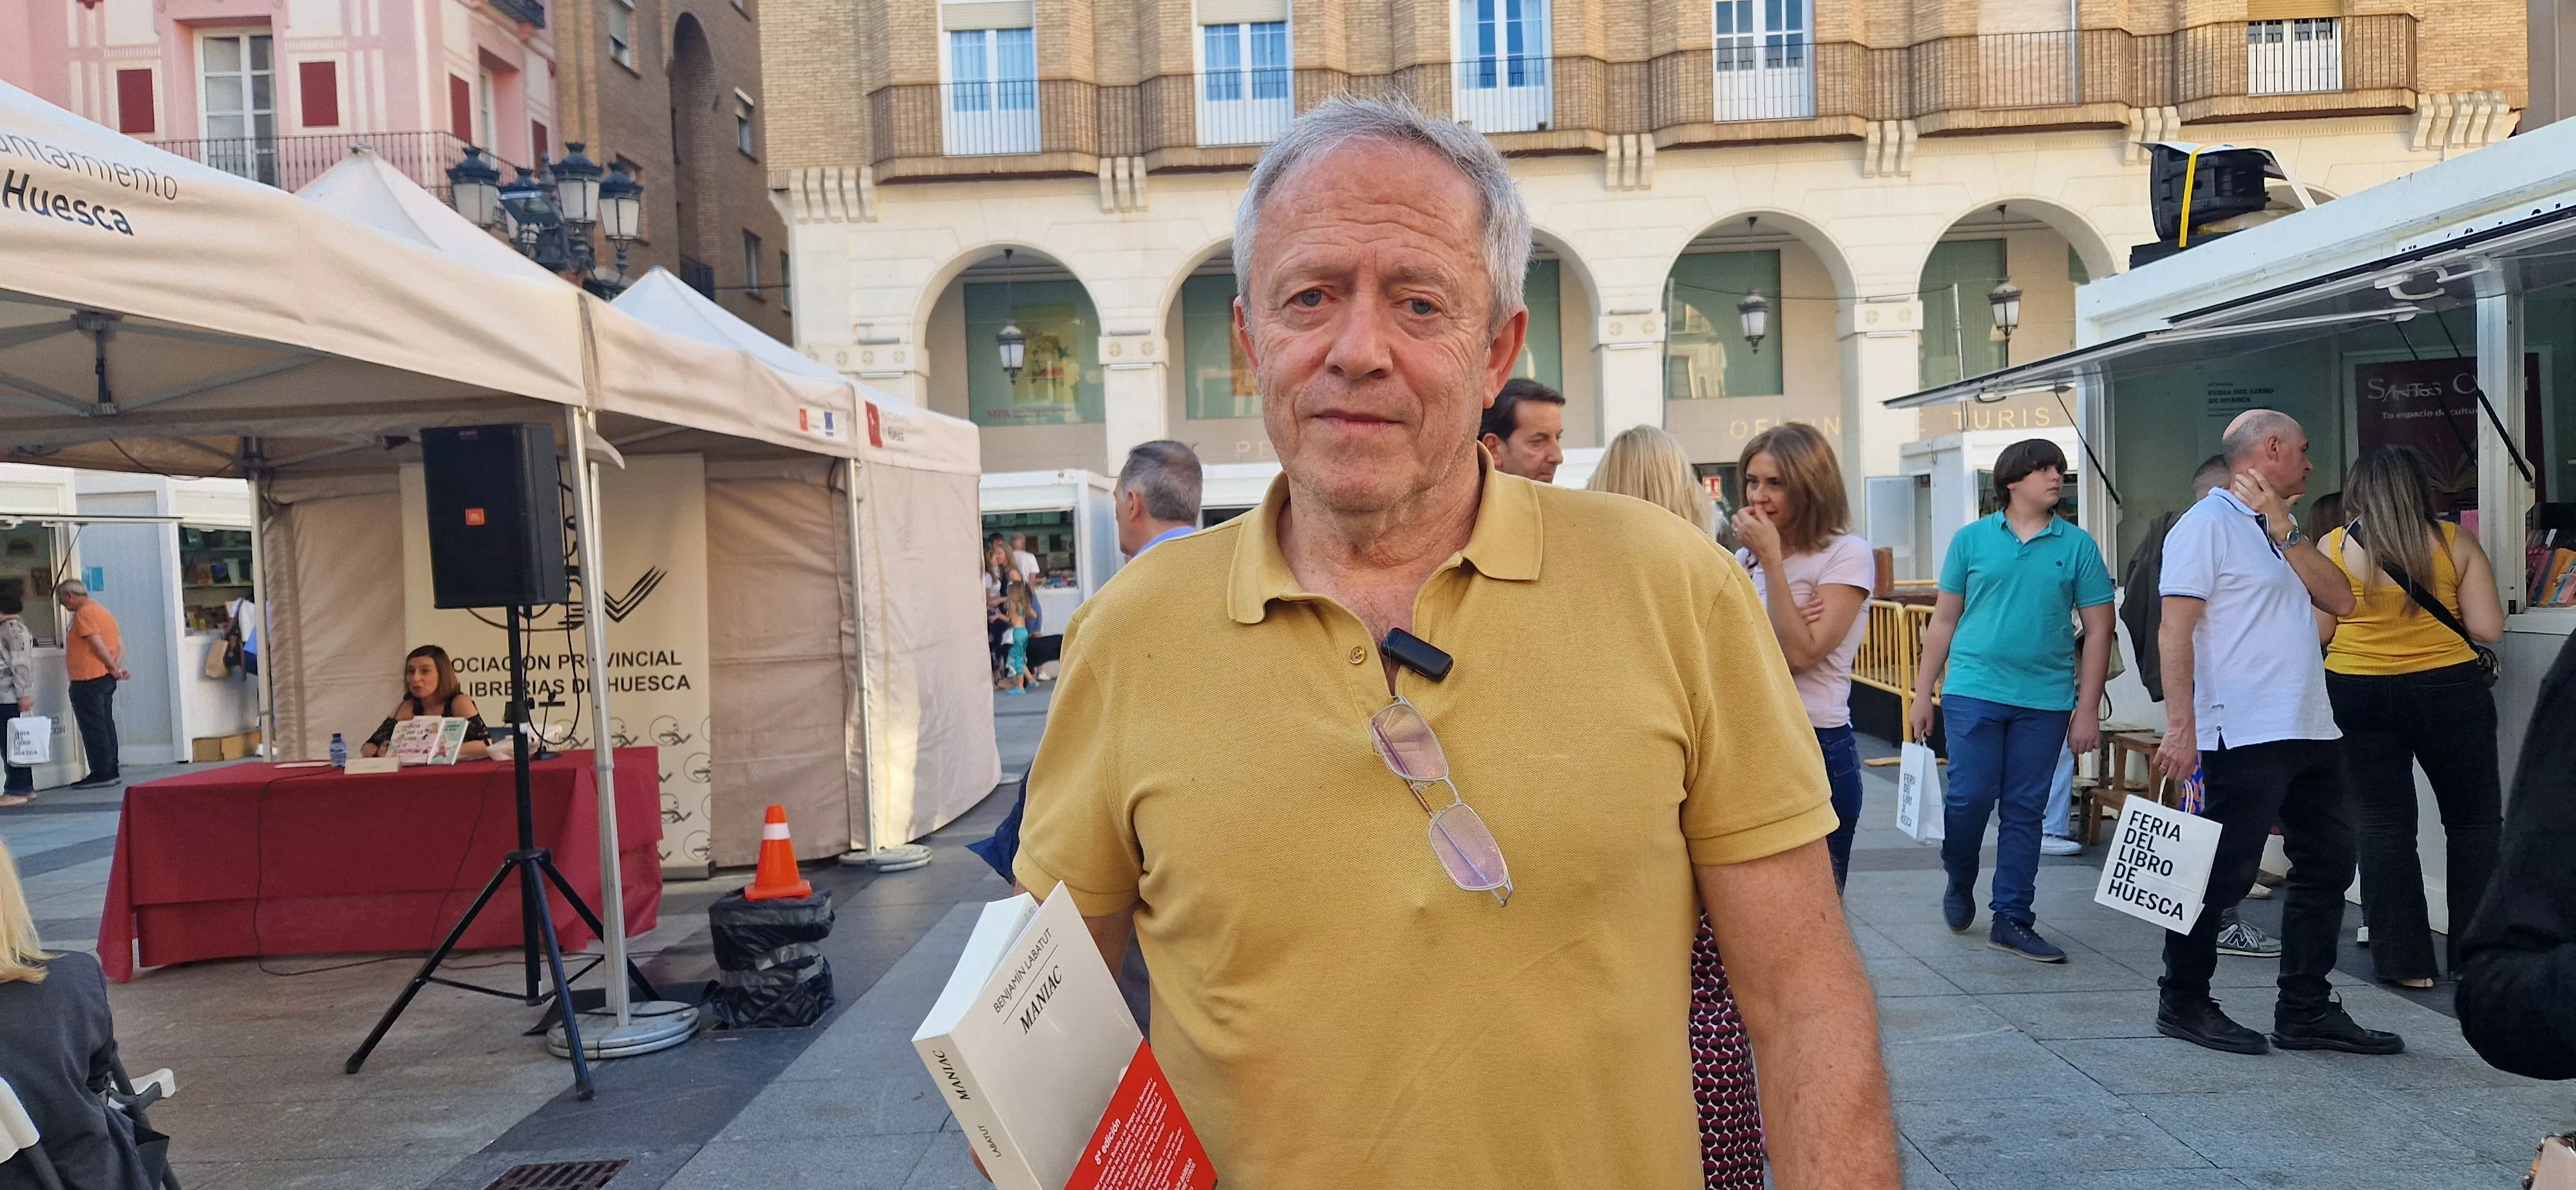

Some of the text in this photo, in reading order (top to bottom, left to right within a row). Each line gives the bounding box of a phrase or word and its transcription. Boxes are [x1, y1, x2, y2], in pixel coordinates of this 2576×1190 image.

[0, 134, 178, 201] untamiento
[2, 168, 134, 236] Huesca
[1951, 406, 2053, 431] TURIS
[558, 650, 682, 670] PRVINCIAL
[607, 674, 691, 693] HUESCA
[2123, 827, 2155, 853] DEL
[2128, 810, 2181, 842] FERIA
[2112, 862, 2138, 884] DE
[2118, 844, 2174, 877] LIBRO
[2107, 879, 2183, 921] HUESCA
[993, 927, 1052, 1014] BENJAMÍN LABATUT
[1019, 964, 1062, 1035] MANIAC
[932, 1049, 971, 1100] MANIAC
[977, 1124, 1002, 1158] LABATUT
[1102, 1119, 1121, 1153] edición
